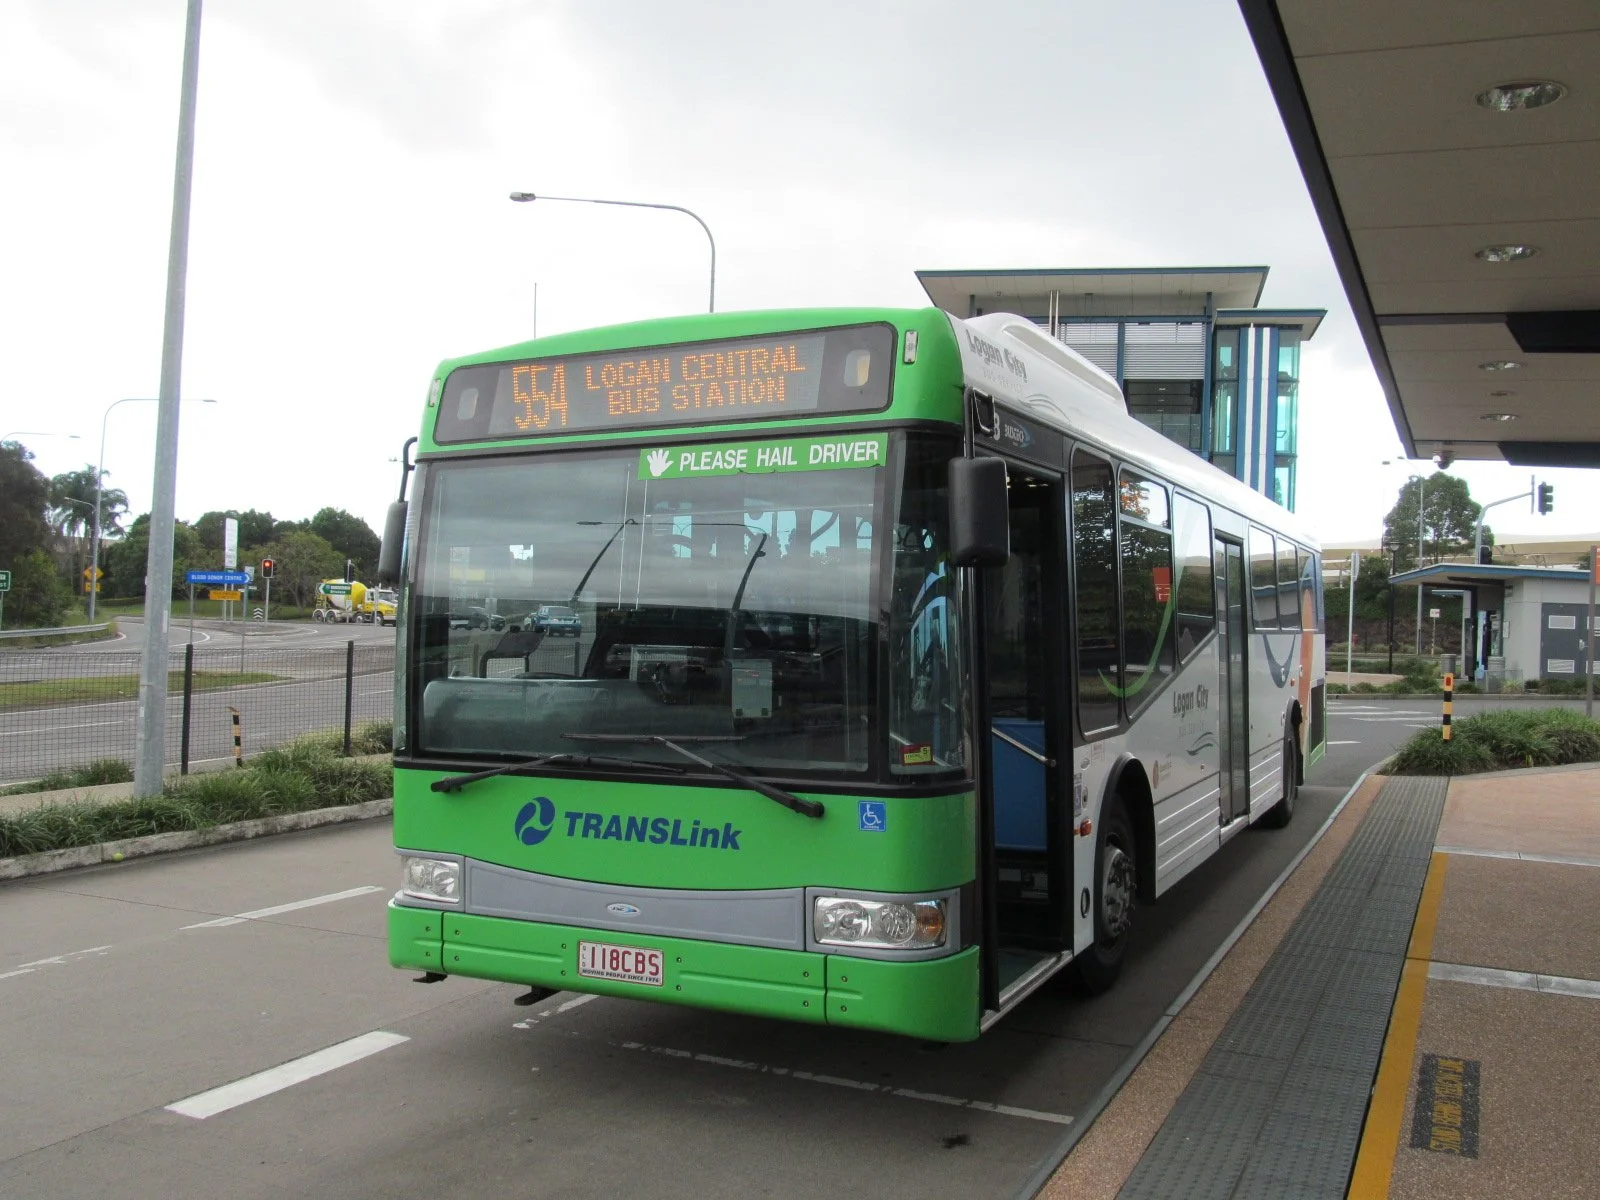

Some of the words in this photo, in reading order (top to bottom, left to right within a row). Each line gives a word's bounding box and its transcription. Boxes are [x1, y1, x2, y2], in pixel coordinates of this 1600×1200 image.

[586, 358, 670, 390] LOGAN
[682, 345, 806, 381] CENTRAL
[966, 329, 1004, 368] Logan
[1003, 348, 1028, 383] City
[513, 362, 568, 428] 554
[608, 387, 660, 415] BUS
[672, 376, 785, 410] STATION
[679, 449, 748, 472] PLEASE
[756, 446, 798, 467] HAIL
[809, 440, 879, 465] DRIVER
[1173, 691, 1194, 719] Logan
[1197, 684, 1209, 710] City
[564, 811, 742, 850] TRANSLink
[582, 968, 605, 977] MOVING
[605, 971, 627, 980] PEOPLE
[627, 974, 645, 982] SINCE
[590, 946, 660, 976] 118CBS
